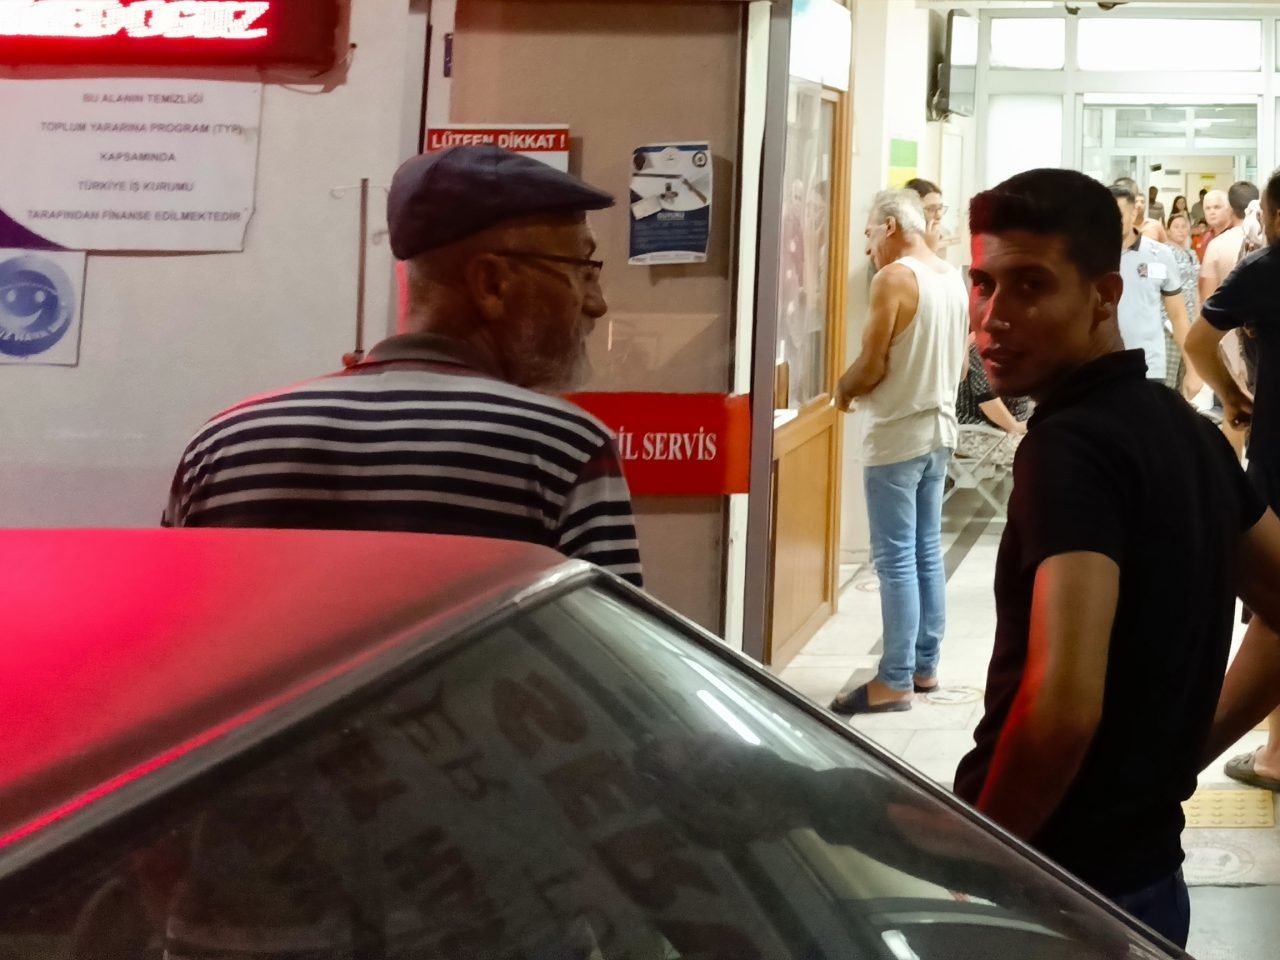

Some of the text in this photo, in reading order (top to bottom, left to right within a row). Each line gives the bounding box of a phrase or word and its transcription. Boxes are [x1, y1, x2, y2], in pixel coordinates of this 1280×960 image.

[498, 131, 556, 149] DİKKAT
[100, 152, 176, 161] KAPSAMINDA
[143, 181, 193, 192] KURUMU
[642, 425, 717, 461] SERVİS
